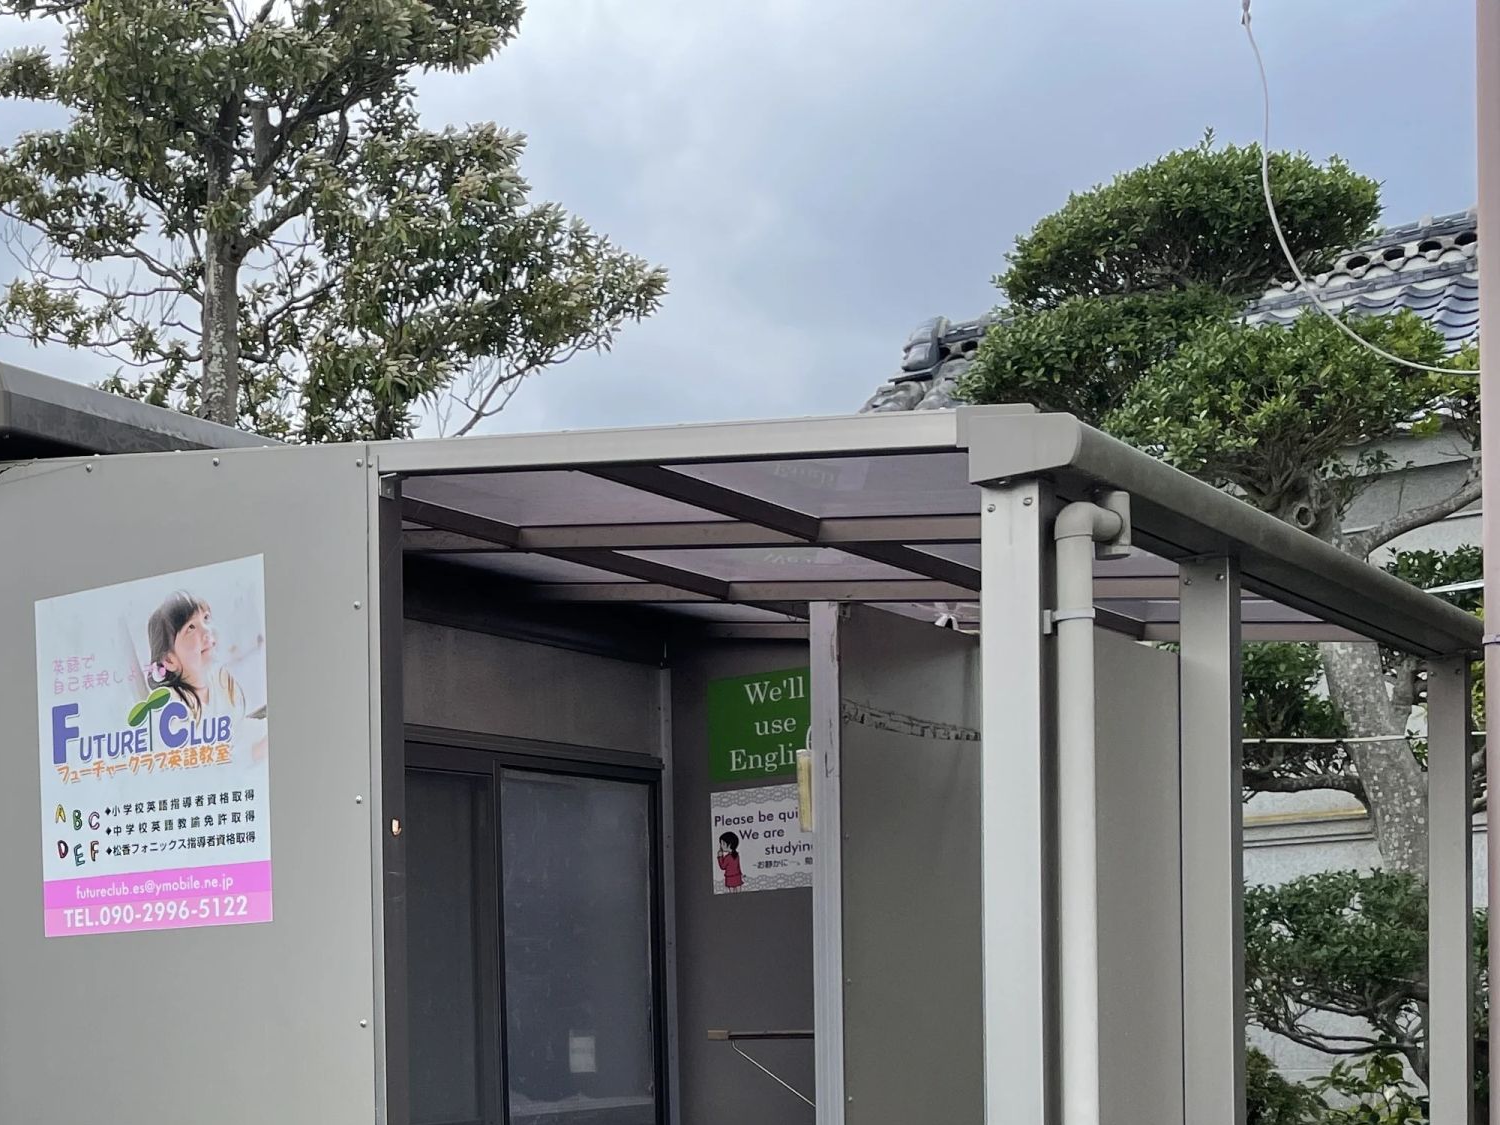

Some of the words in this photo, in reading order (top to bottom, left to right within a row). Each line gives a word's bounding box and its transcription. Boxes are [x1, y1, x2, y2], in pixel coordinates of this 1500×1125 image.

[744, 676, 805, 705] We'll
[52, 702, 148, 765] FUTURE
[159, 701, 231, 749] CLUB
[754, 717, 797, 736] use
[729, 743, 796, 772] Engli
[714, 815, 754, 827] Please
[758, 810, 774, 823] be
[778, 807, 799, 823] qui
[739, 829, 759, 840] We
[763, 829, 785, 839] are
[764, 840, 813, 856] studyin
[76, 874, 234, 900] futureclub.es@ymobile.ne.jp
